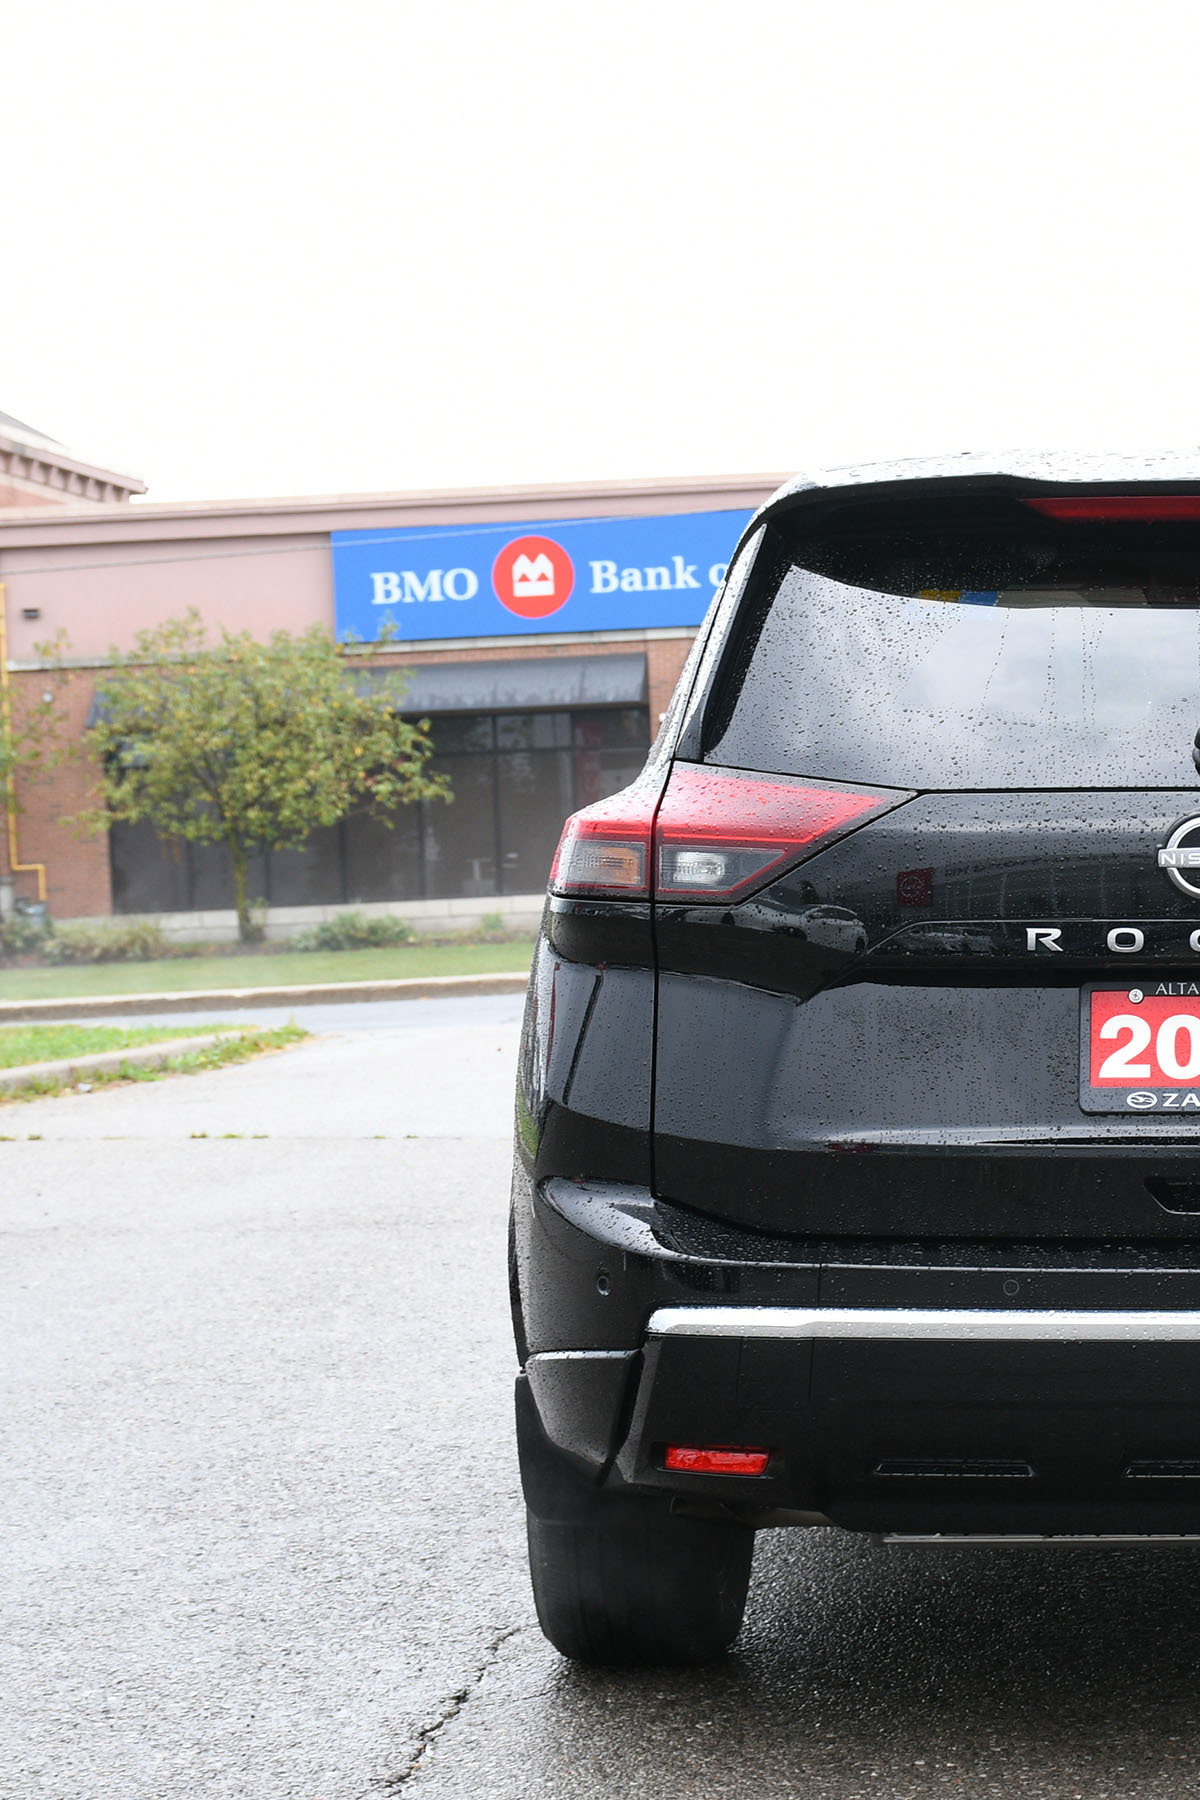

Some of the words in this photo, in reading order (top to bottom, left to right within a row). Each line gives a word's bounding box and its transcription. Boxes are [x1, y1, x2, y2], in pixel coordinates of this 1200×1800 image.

[370, 567, 479, 605] BMO
[588, 555, 701, 594] Bank
[1155, 982, 1200, 996] ALTA
